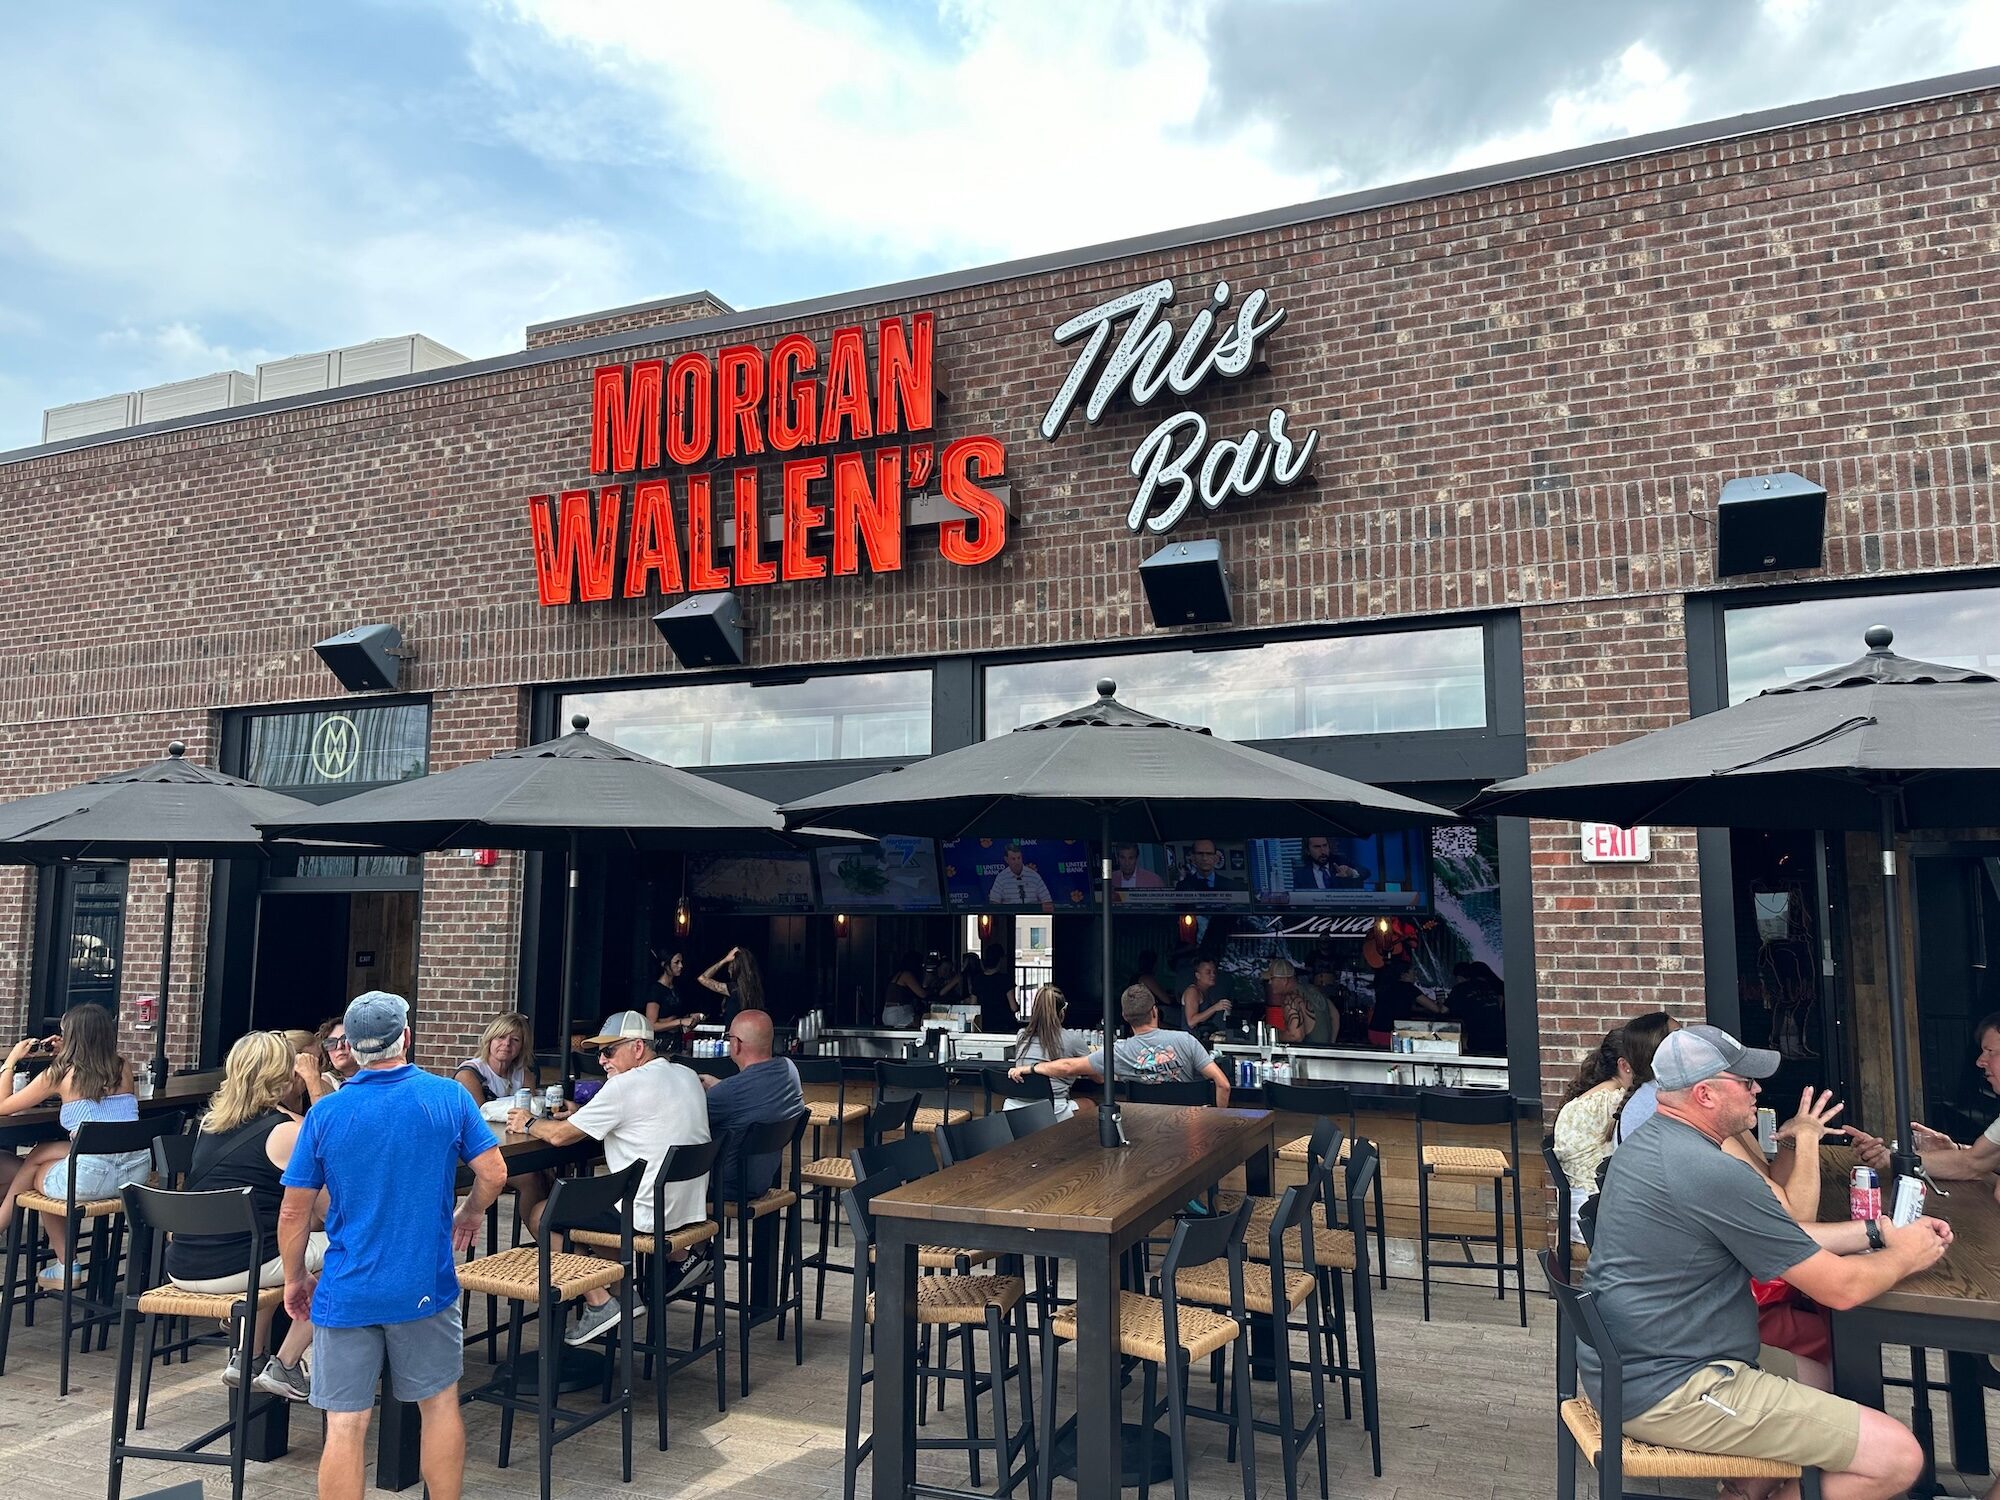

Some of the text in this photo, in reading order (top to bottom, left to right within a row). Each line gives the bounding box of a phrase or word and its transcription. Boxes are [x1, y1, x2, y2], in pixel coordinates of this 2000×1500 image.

[590, 311, 934, 475] MORGAN
[1040, 278, 1288, 441] This
[528, 435, 1006, 607] WALLEN'S
[1127, 407, 1320, 533] Bar
[1595, 826, 1638, 856] EXIT
[679, 1254, 698, 1274] HOKA
